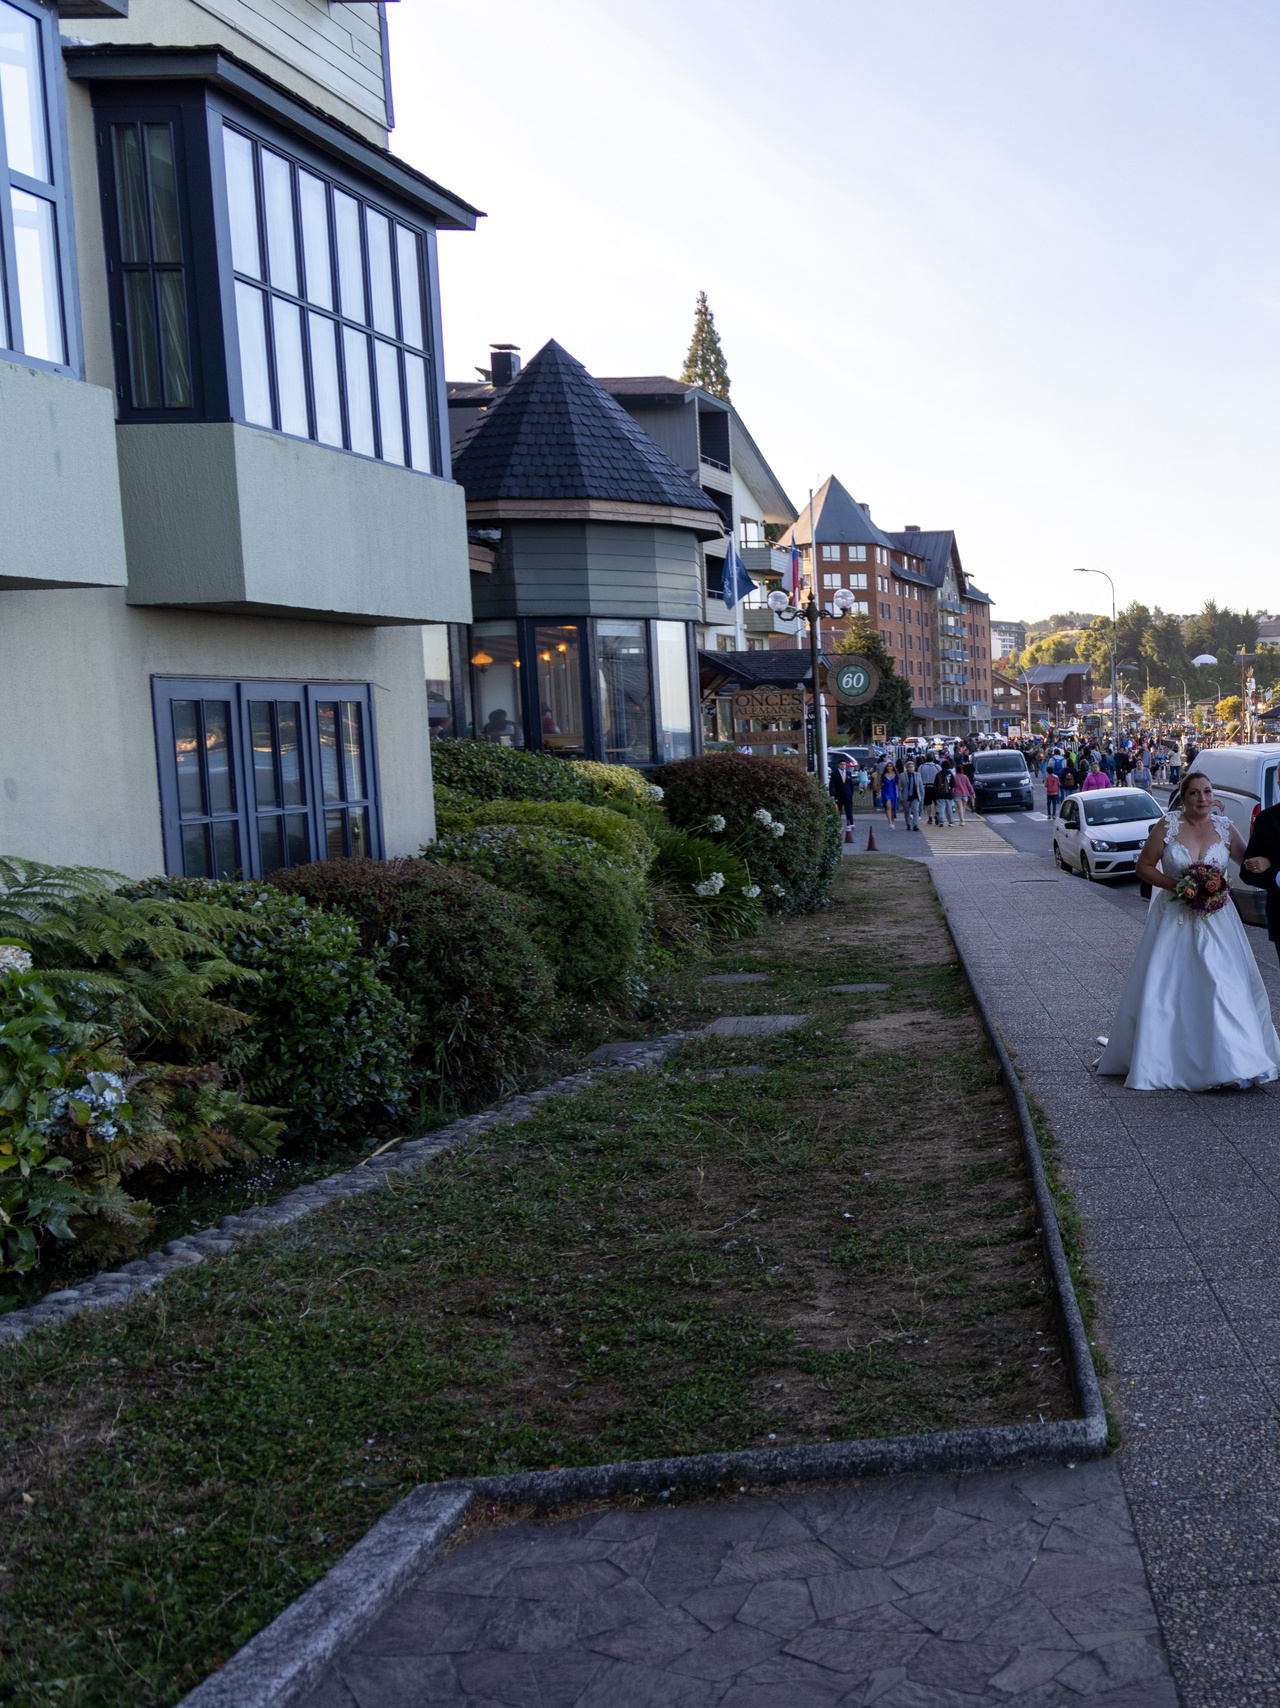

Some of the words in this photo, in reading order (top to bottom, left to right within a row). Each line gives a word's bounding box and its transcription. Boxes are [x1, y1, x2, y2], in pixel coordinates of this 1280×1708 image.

[842, 673, 864, 688] 60
[735, 693, 802, 707] ONCES
[735, 706, 803, 715] ALEMANAS
